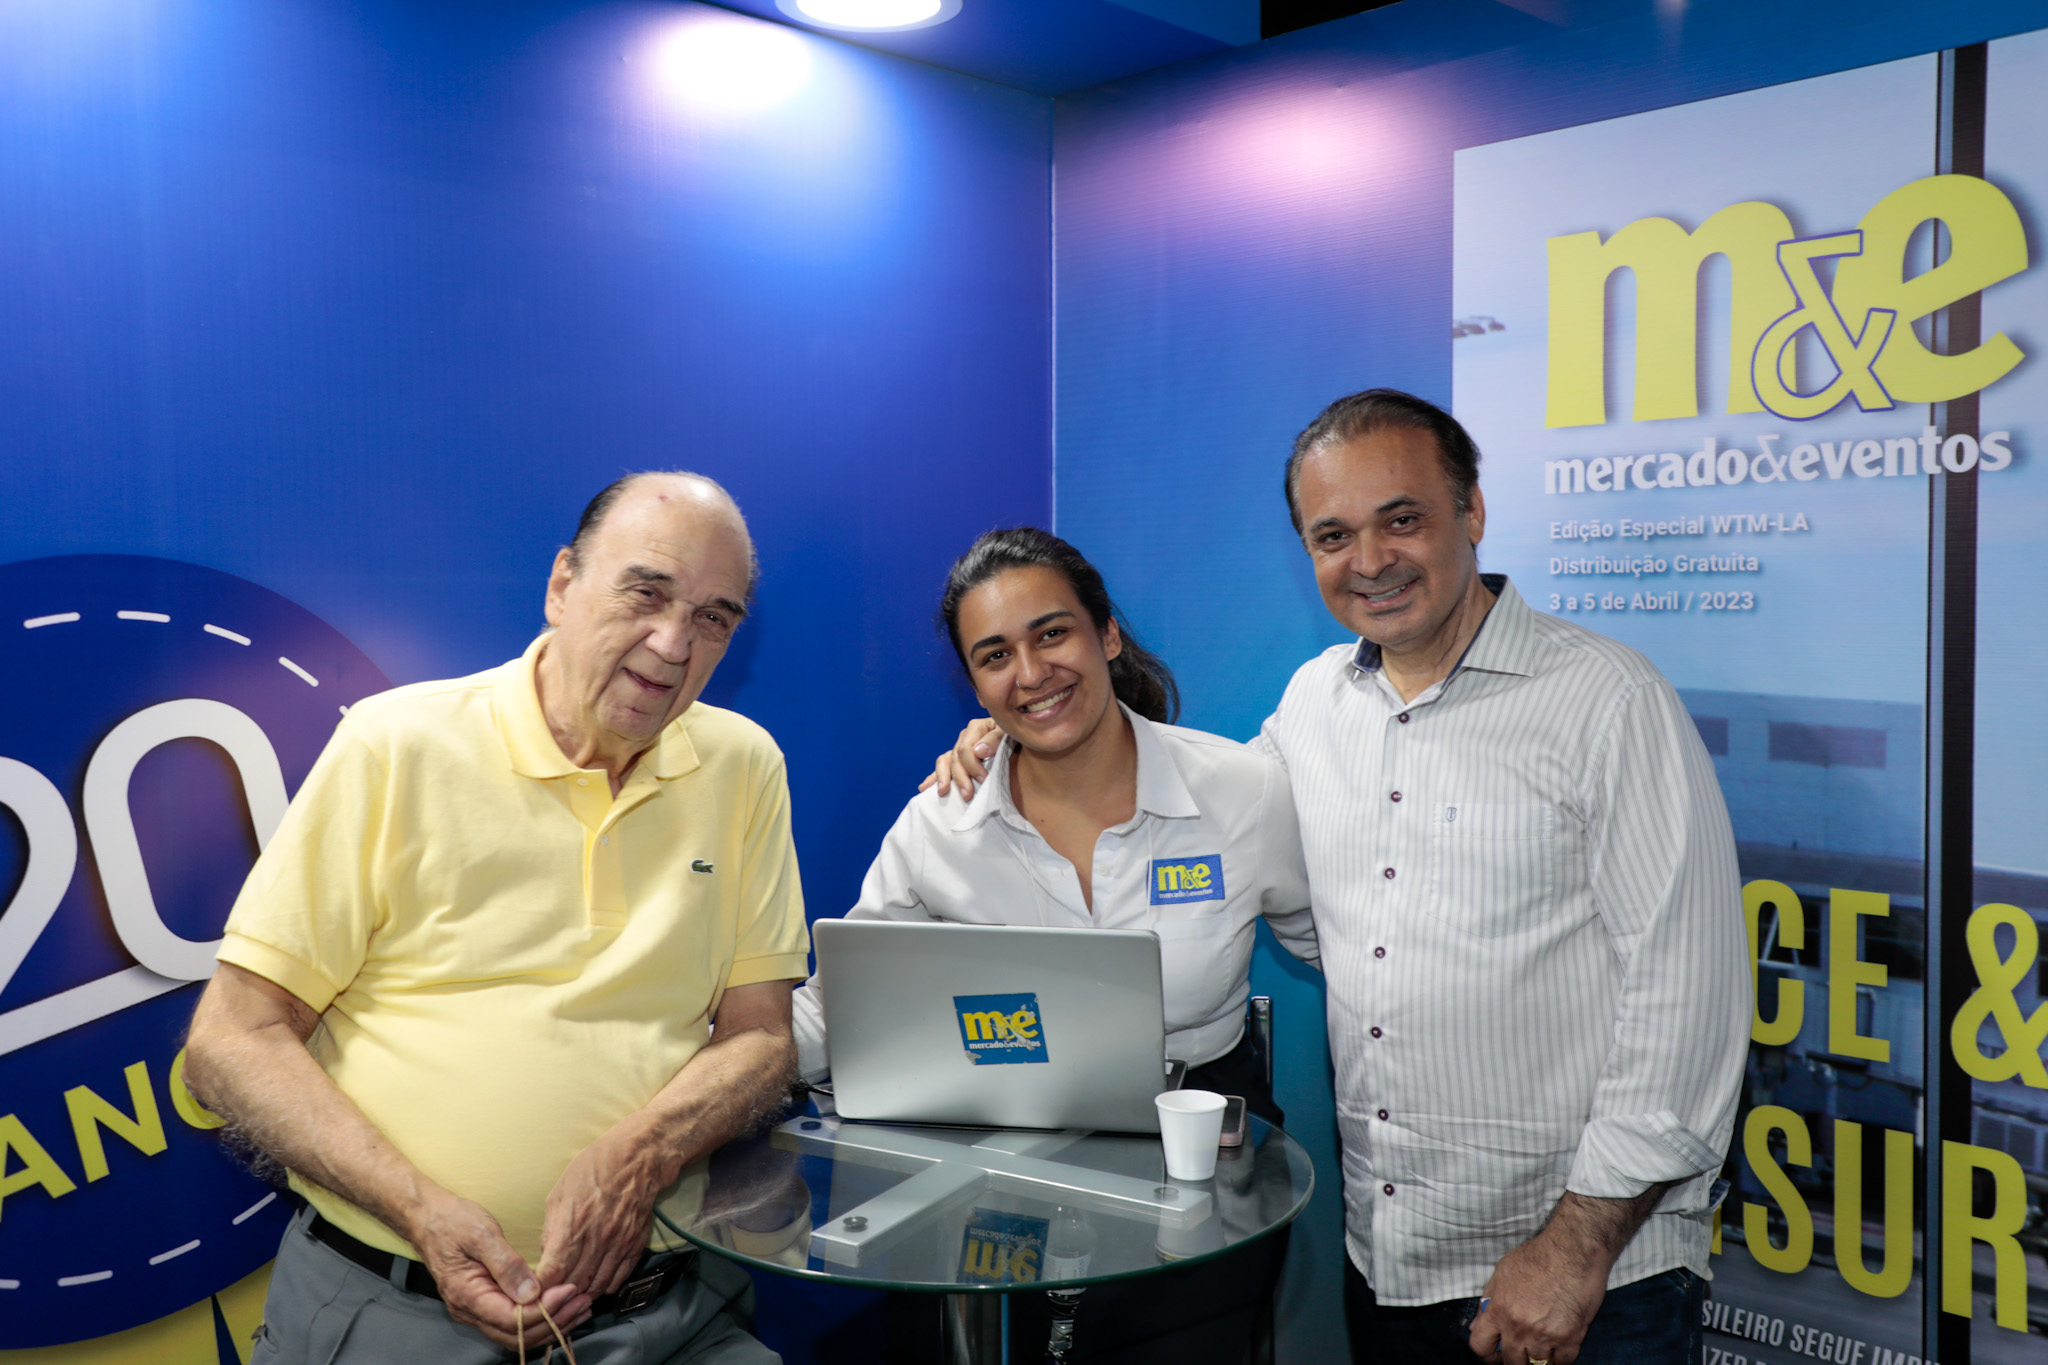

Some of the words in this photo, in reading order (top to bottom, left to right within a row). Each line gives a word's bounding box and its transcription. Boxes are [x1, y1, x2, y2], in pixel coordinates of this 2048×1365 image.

[1545, 174, 2029, 428] m&e
[1544, 426, 2013, 494] mercado&eventos
[1550, 520, 1614, 542] Edição
[1620, 515, 1705, 540] Especial
[1711, 512, 1809, 534] WTM-LA
[1550, 554, 1667, 578] Distribuição
[1673, 552, 1759, 573] Gratuita
[1549, 593, 1562, 610] 3
[1566, 596, 1578, 610] a
[1584, 593, 1596, 610] 5
[1600, 591, 1626, 610] de
[1630, 591, 1679, 610] Abril
[1699, 591, 1754, 610] 2023
[1157, 863, 1212, 891] m&e
[969, 1040, 1042, 1050] mercado&evos
[1710, 1104, 2028, 1333] SUR
[1790, 1324, 1866, 1365] SEGUE
